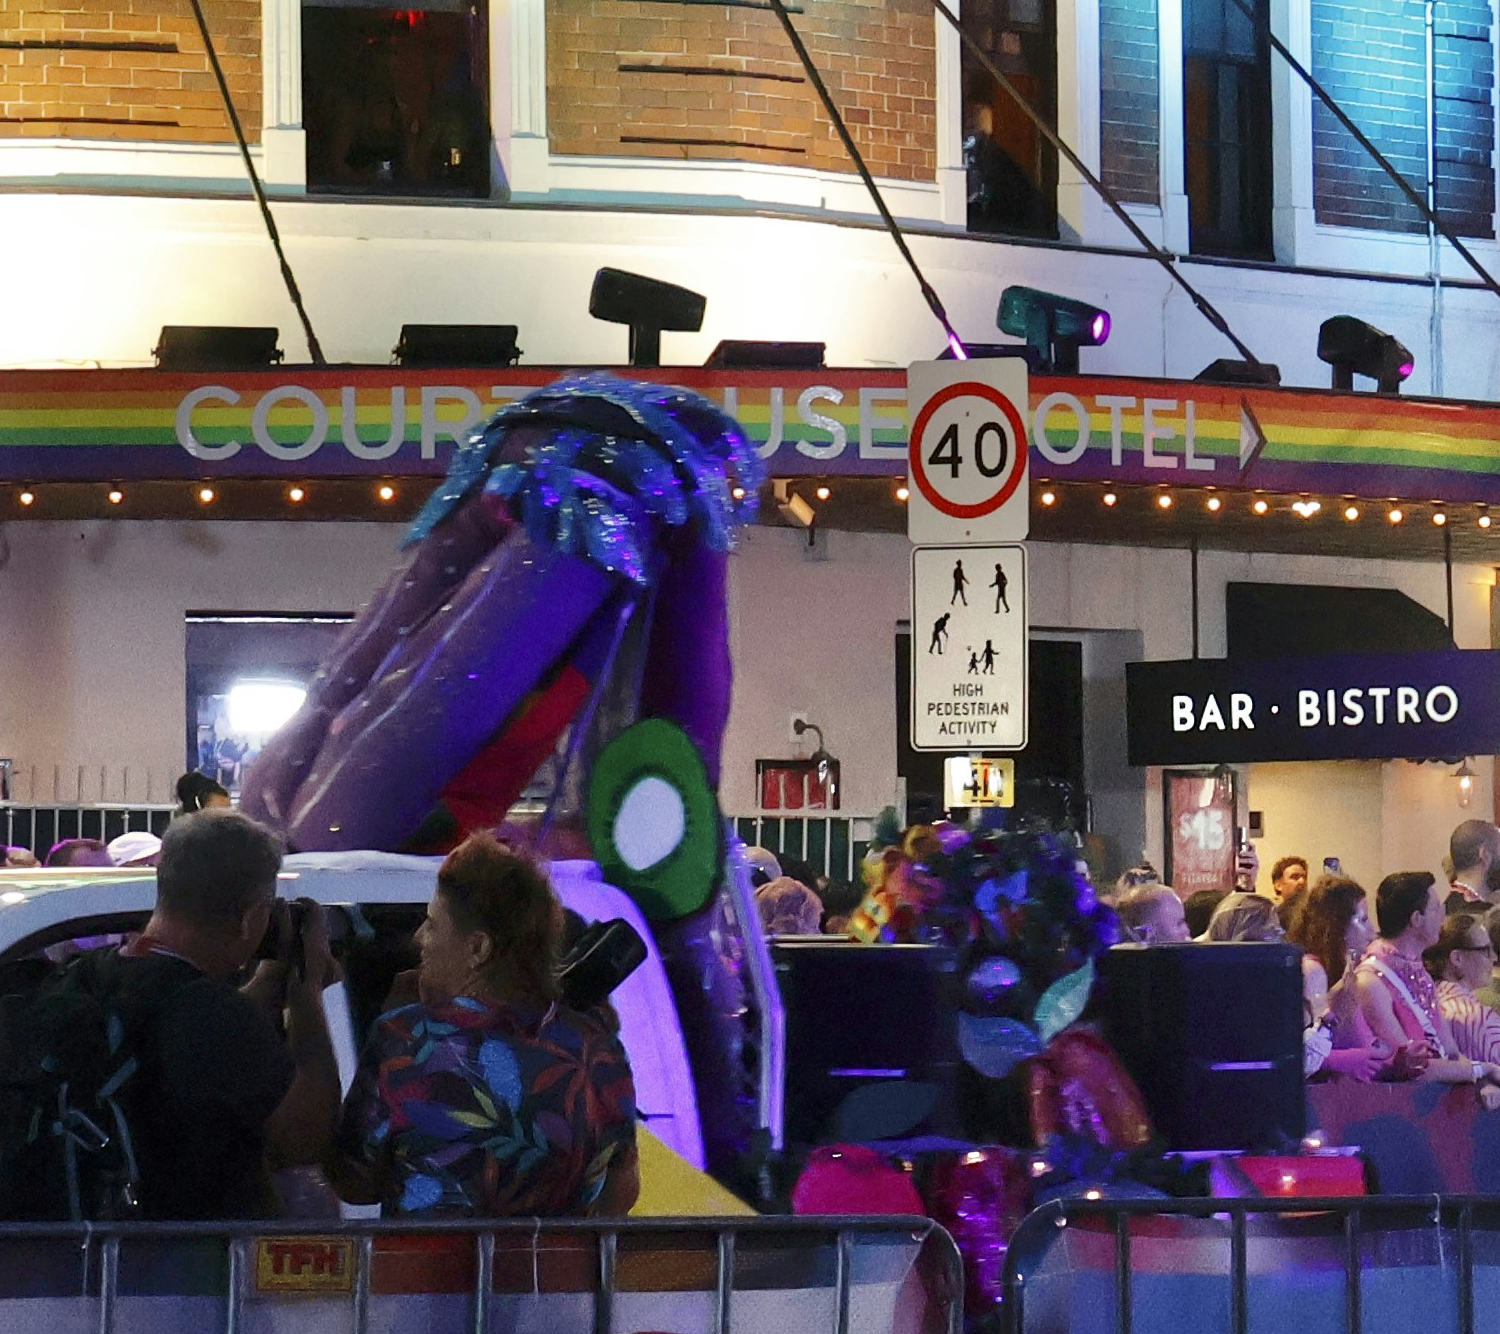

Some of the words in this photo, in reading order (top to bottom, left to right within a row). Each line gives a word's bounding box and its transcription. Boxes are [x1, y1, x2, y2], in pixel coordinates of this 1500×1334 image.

[1033, 390, 1216, 472] OTEL
[927, 421, 1008, 479] 40
[953, 683, 984, 697] HIGH
[927, 702, 1009, 716] PEDESTRIAN
[1172, 693, 1255, 732] BAR
[1298, 685, 1459, 727] BISTRO
[938, 720, 997, 735] ACTIVITY
